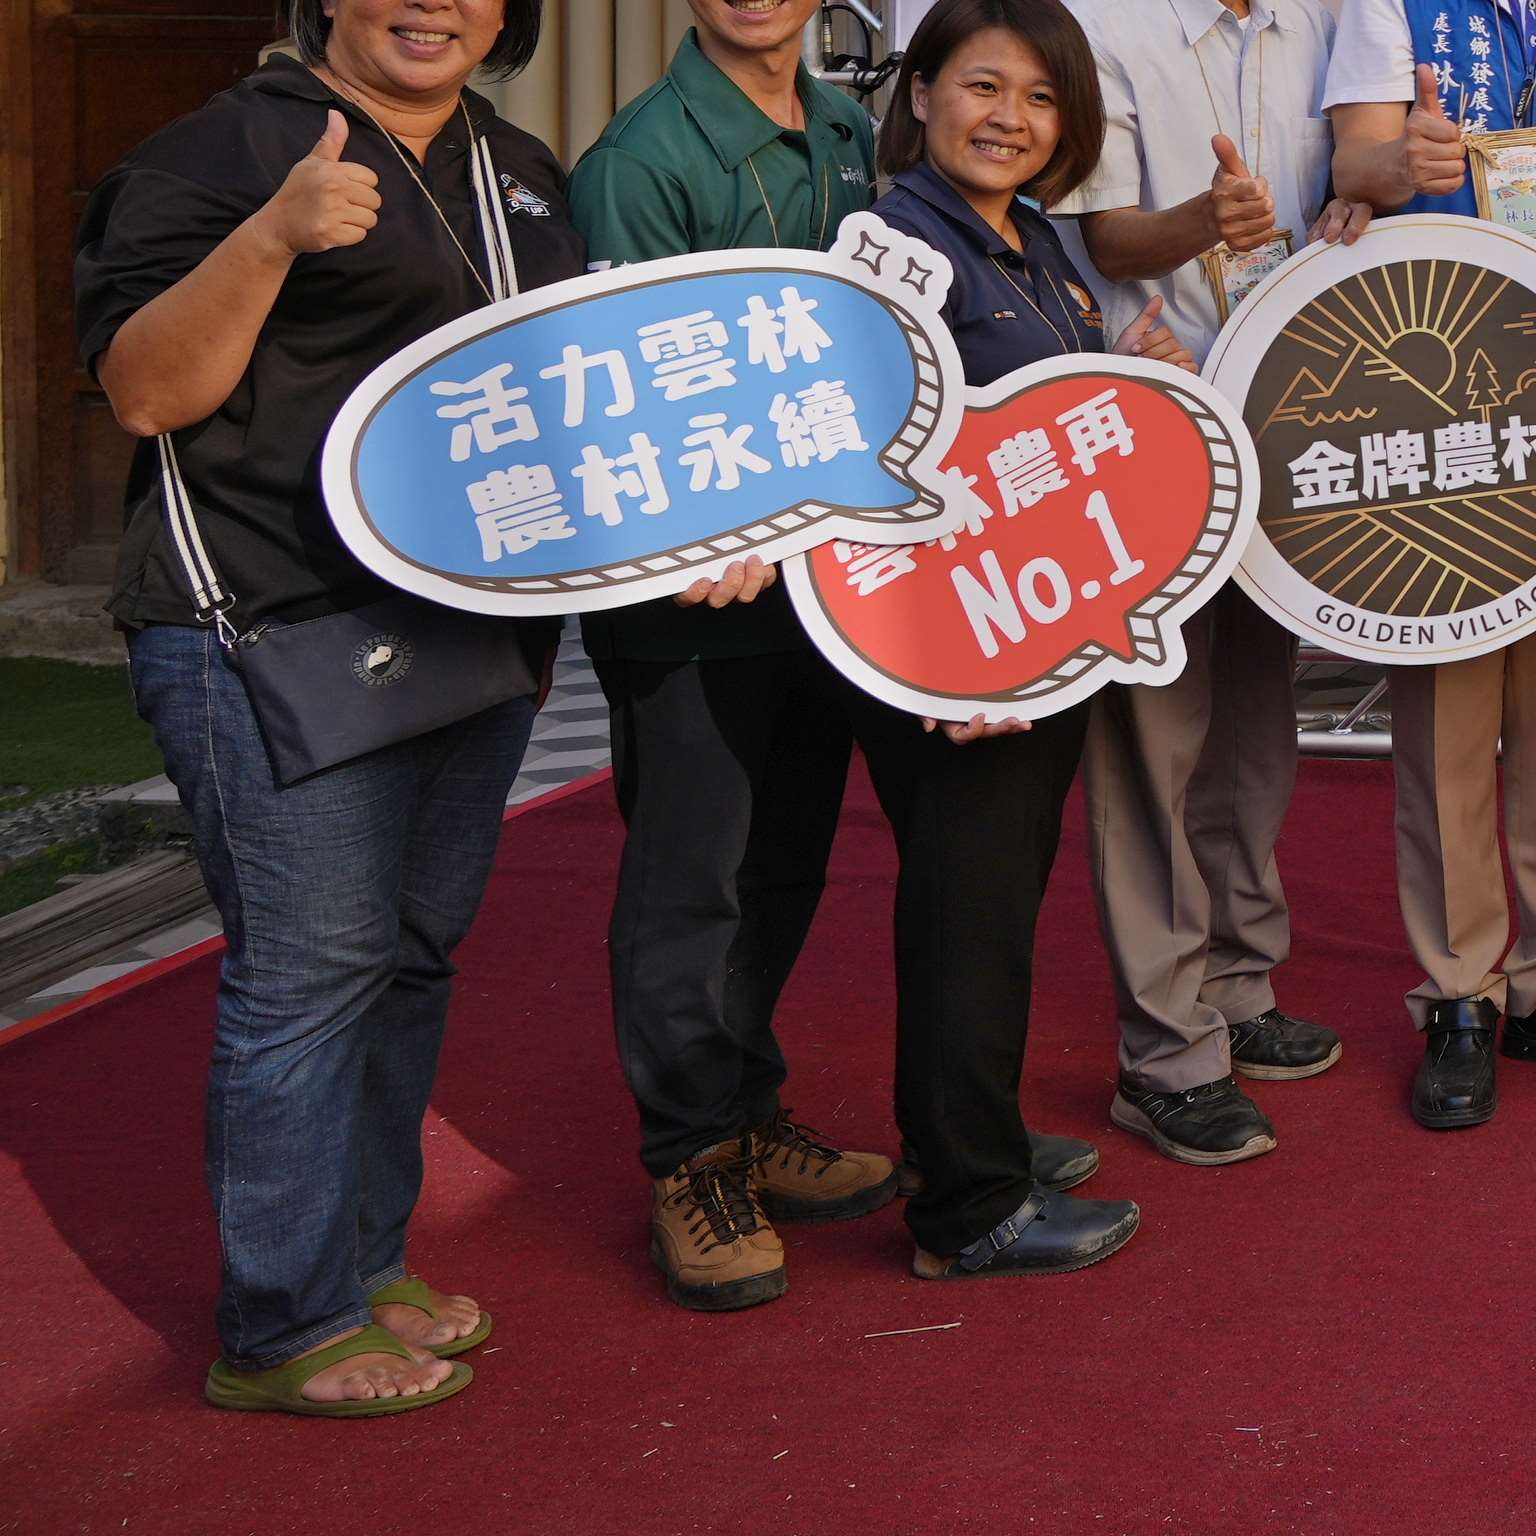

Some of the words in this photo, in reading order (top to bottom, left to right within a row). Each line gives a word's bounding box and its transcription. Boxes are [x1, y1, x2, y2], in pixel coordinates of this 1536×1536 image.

[429, 286, 835, 463] 活力雲林
[464, 378, 870, 563] 農村永續
[950, 489, 1145, 659] No.1
[1314, 602, 1435, 645] GOLDEN
